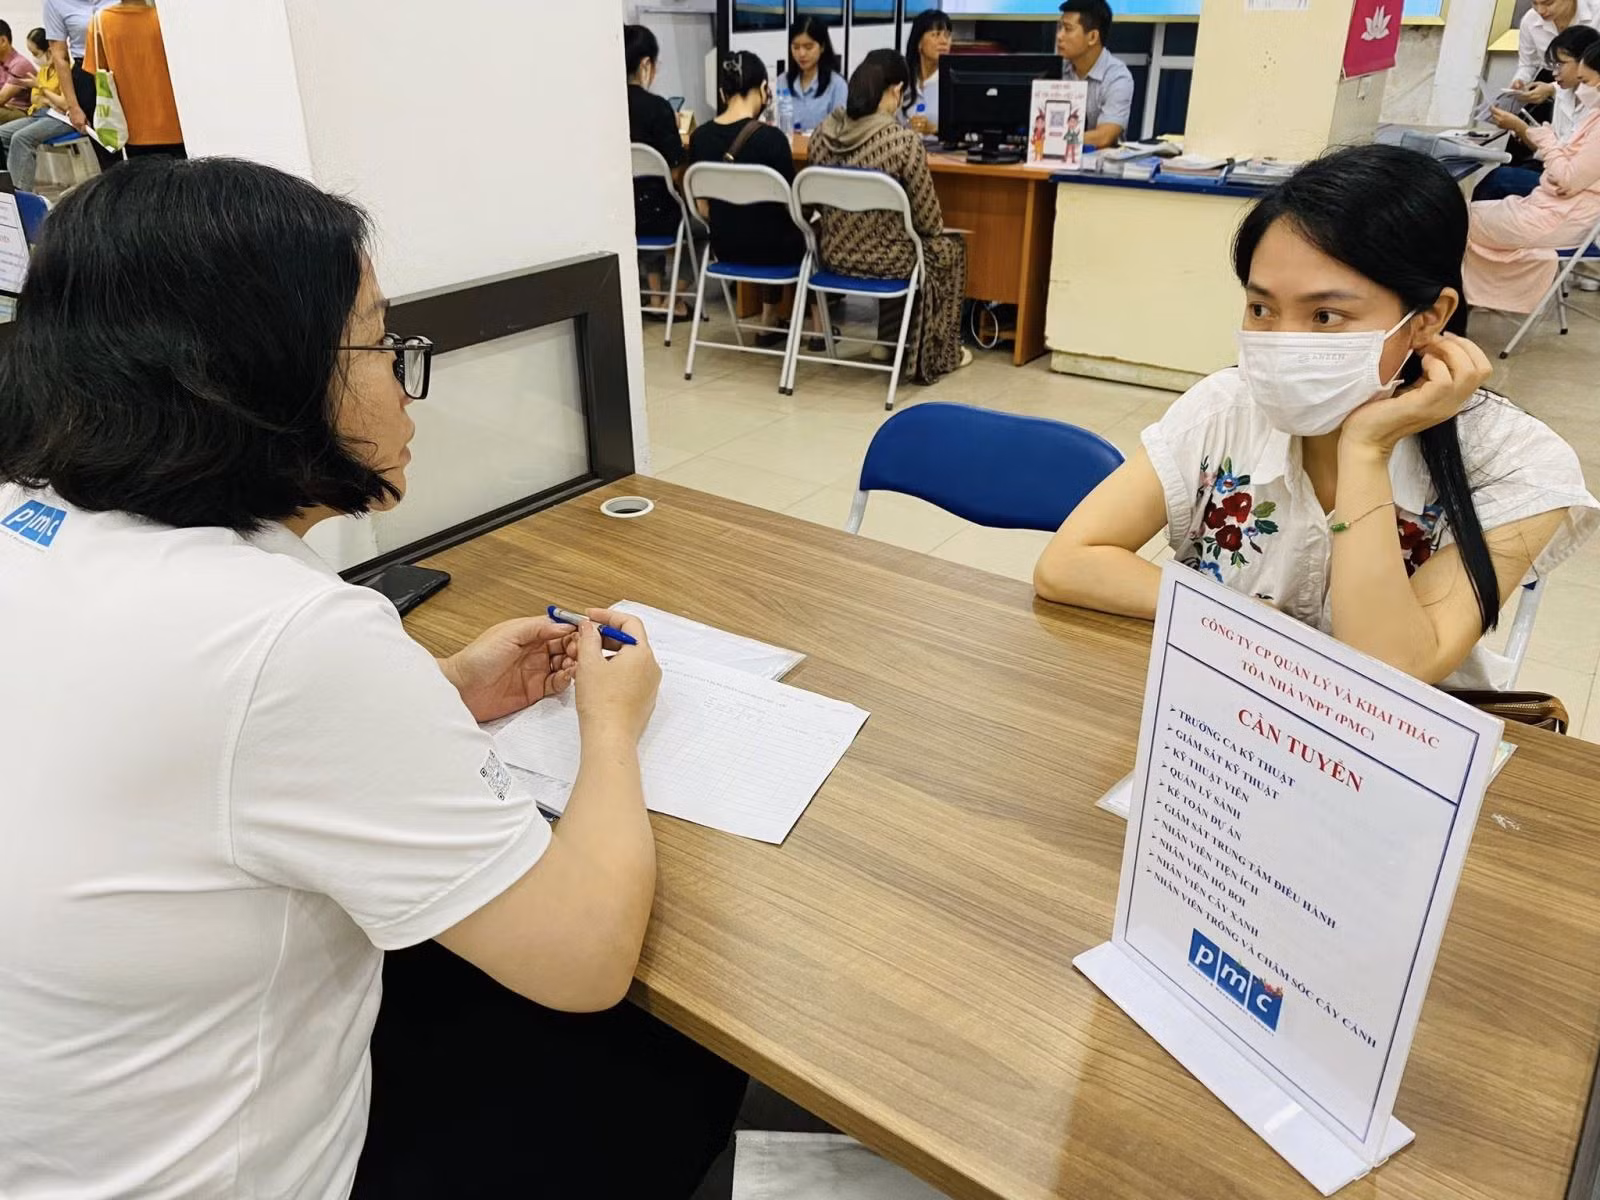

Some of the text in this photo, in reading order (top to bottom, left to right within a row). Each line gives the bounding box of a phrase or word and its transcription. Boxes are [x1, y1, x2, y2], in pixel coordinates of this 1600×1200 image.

[6, 508, 60, 536] pmc
[1201, 616, 1235, 641] CÔNG
[1237, 634, 1252, 650] TY
[1255, 645, 1272, 660] CP
[1312, 674, 1330, 691] LÝ
[1335, 685, 1352, 704] VÀ
[1356, 697, 1393, 725] KHAI
[1398, 719, 1440, 747] THÁC
[1269, 675, 1294, 698] NHÀ
[1299, 691, 1332, 717] VNPT
[1334, 713, 1375, 741] (PMC)
[1172, 747, 1248, 803] KỸ THUẬT VIÊN
[1175, 729, 1279, 800] GIÁM SÁT KỸ THUẬT
[1179, 709, 1297, 787] TRƯỞNG CA KỸ THUẬT
[1238, 709, 1363, 793] CẦN TUYỂN
[1183, 796, 1208, 819] TOÁN
[1210, 814, 1224, 831] DỰ
[1227, 825, 1241, 841] ÁN
[1198, 785, 1212, 800] LÝ
[1160, 837, 1185, 862] NHÂN
[1187, 857, 1209, 880] VIÊN
[1162, 820, 1259, 896] NHÂN VIÊN TIỆN ÍCH
[1164, 803, 1190, 826] GIÁM
[1191, 822, 1210, 839] SÁT
[1212, 836, 1246, 866] TRUNG
[1249, 862, 1272, 884] TÂM
[1302, 900, 1336, 929] HÀNH
[1157, 855, 1259, 937] NHÂN VIÊN CÂY XANH
[1154, 871, 1179, 896] NHÂN
[1181, 892, 1203, 915] VIÊN
[1241, 938, 1255, 956] VÀ
[1256, 952, 1290, 982] CHĂM
[1291, 977, 1313, 998] SÓC
[1315, 997, 1340, 1019] CÂY
[1194, 943, 1273, 1013] pmc
